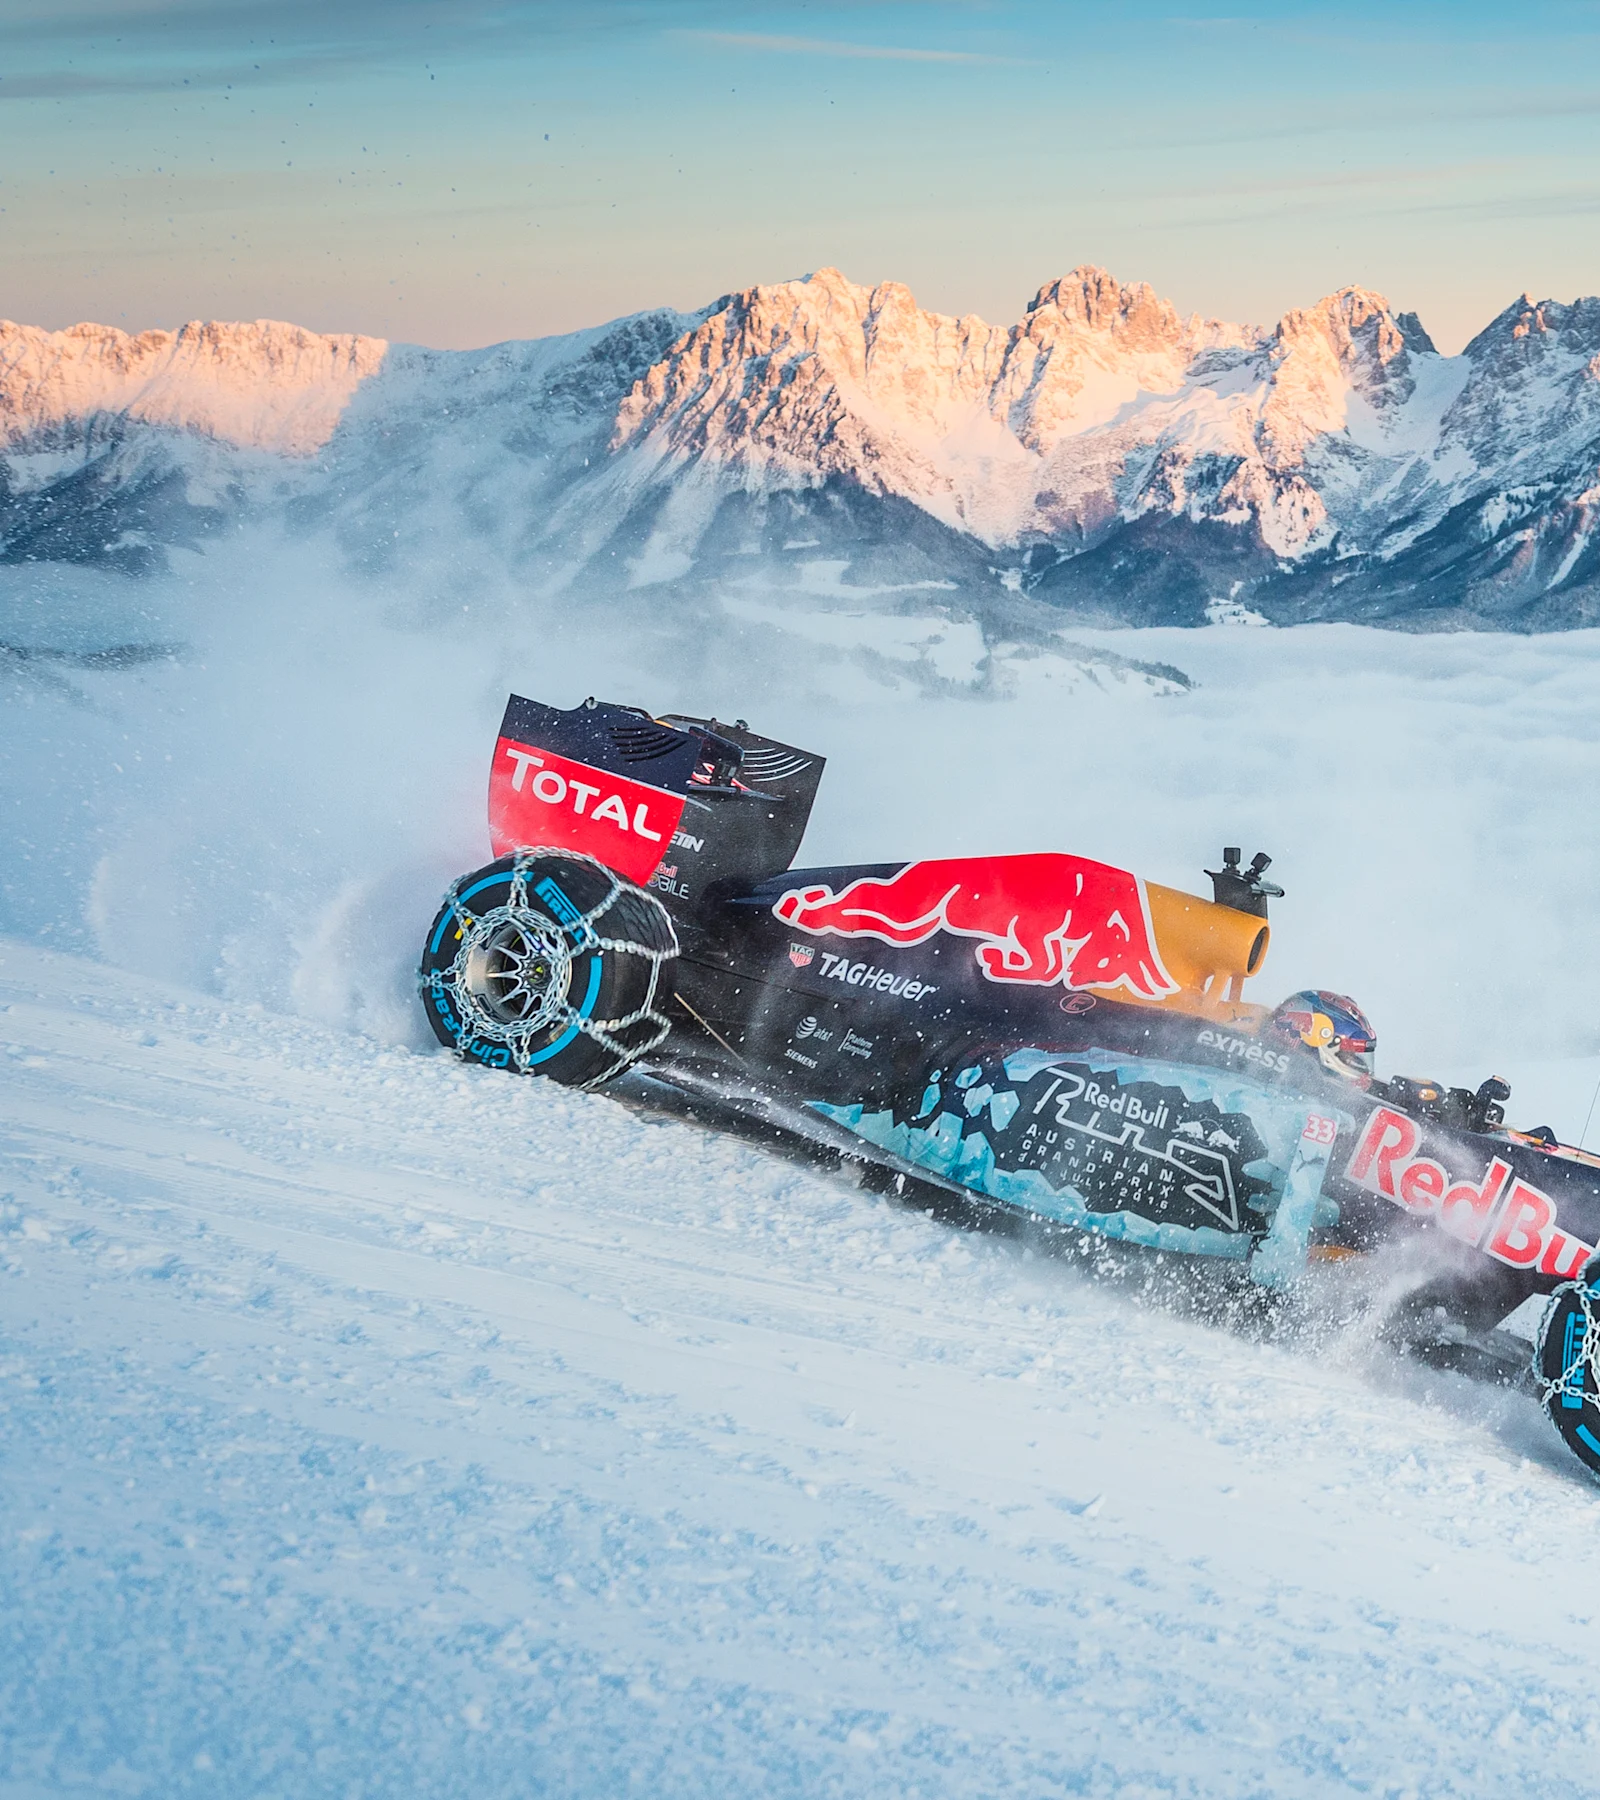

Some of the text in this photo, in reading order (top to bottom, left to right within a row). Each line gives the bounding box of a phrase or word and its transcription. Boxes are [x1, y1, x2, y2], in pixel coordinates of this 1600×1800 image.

[506, 748, 662, 842] TOTAL
[669, 830, 705, 853] ETIN
[784, 1048, 818, 1069] SIEMENS
[1197, 1030, 1290, 1073] exness
[1302, 1113, 1337, 1145] 33
[1022, 1139, 1171, 1199] GRAND PRIX
[1026, 1123, 1174, 1183] AUSTRIAN
[1119, 1187, 1169, 1210] 2016
